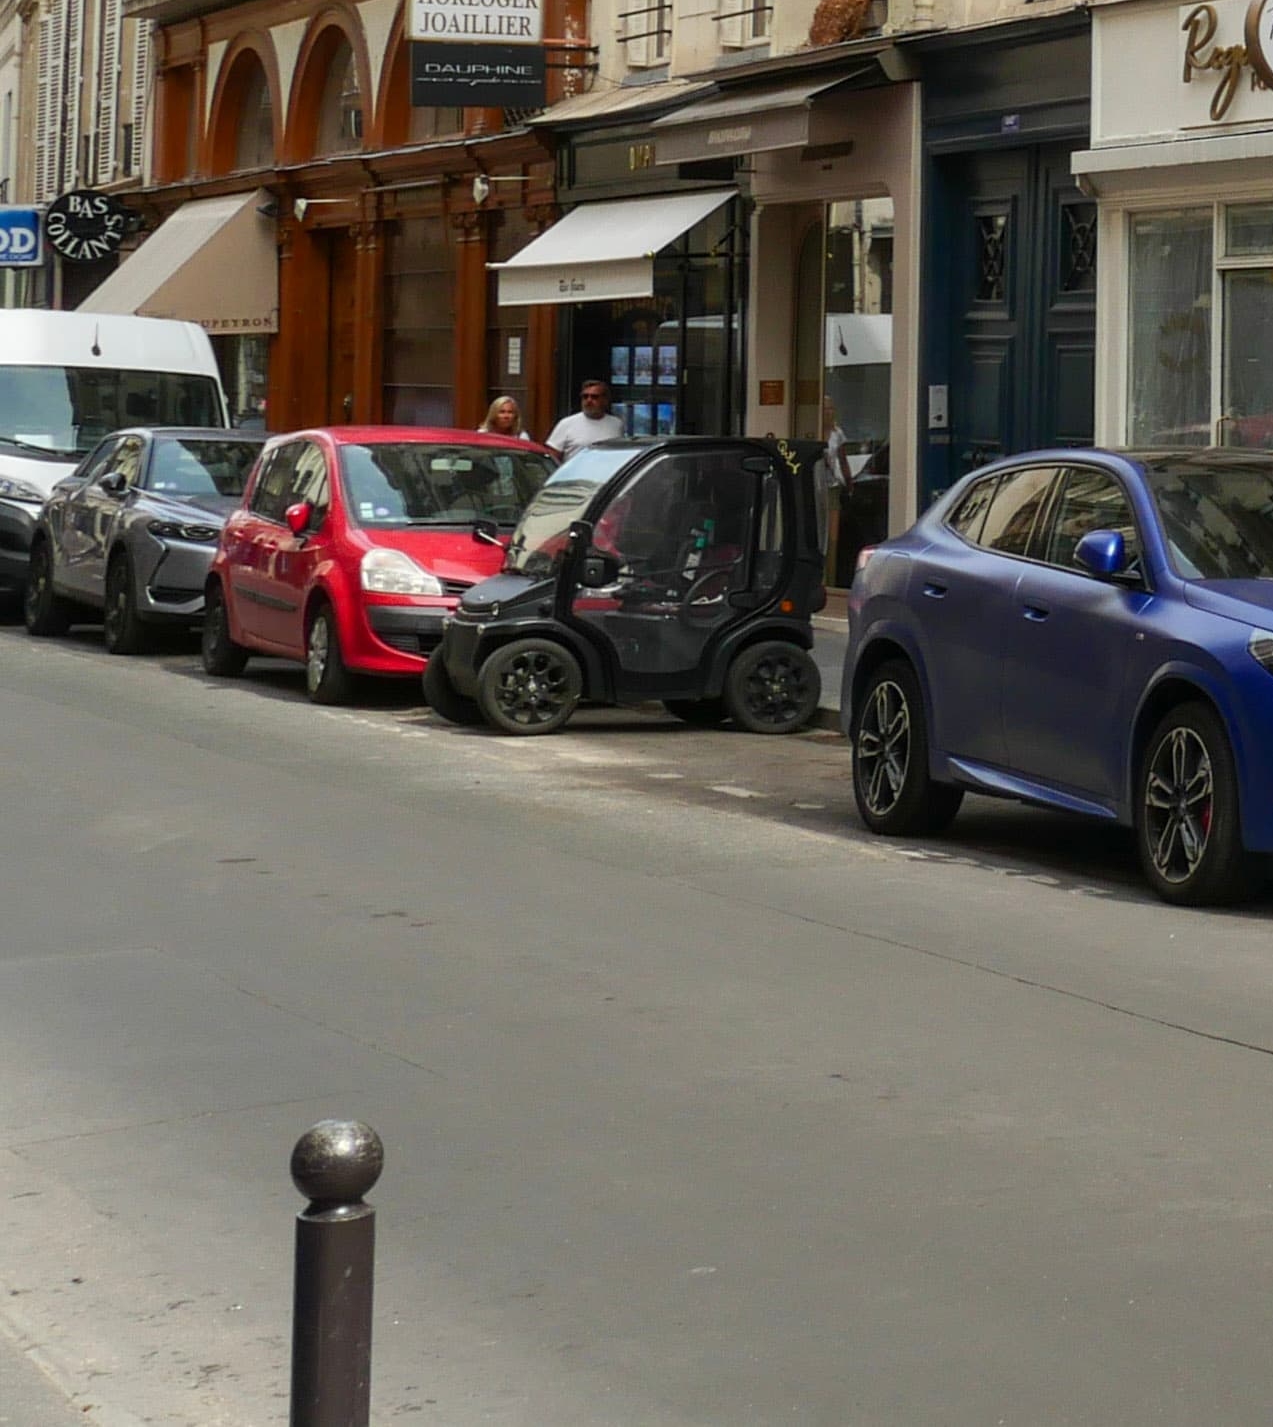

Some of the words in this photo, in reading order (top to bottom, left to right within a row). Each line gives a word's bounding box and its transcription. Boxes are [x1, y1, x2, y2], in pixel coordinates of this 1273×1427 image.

[420, 12, 532, 37] JOAILLIER
[425, 63, 534, 75] DAUPHINE
[68, 195, 109, 219] BAS
[47, 212, 124, 260] COLLANTS
[200, 317, 272, 329] UPEYRON
